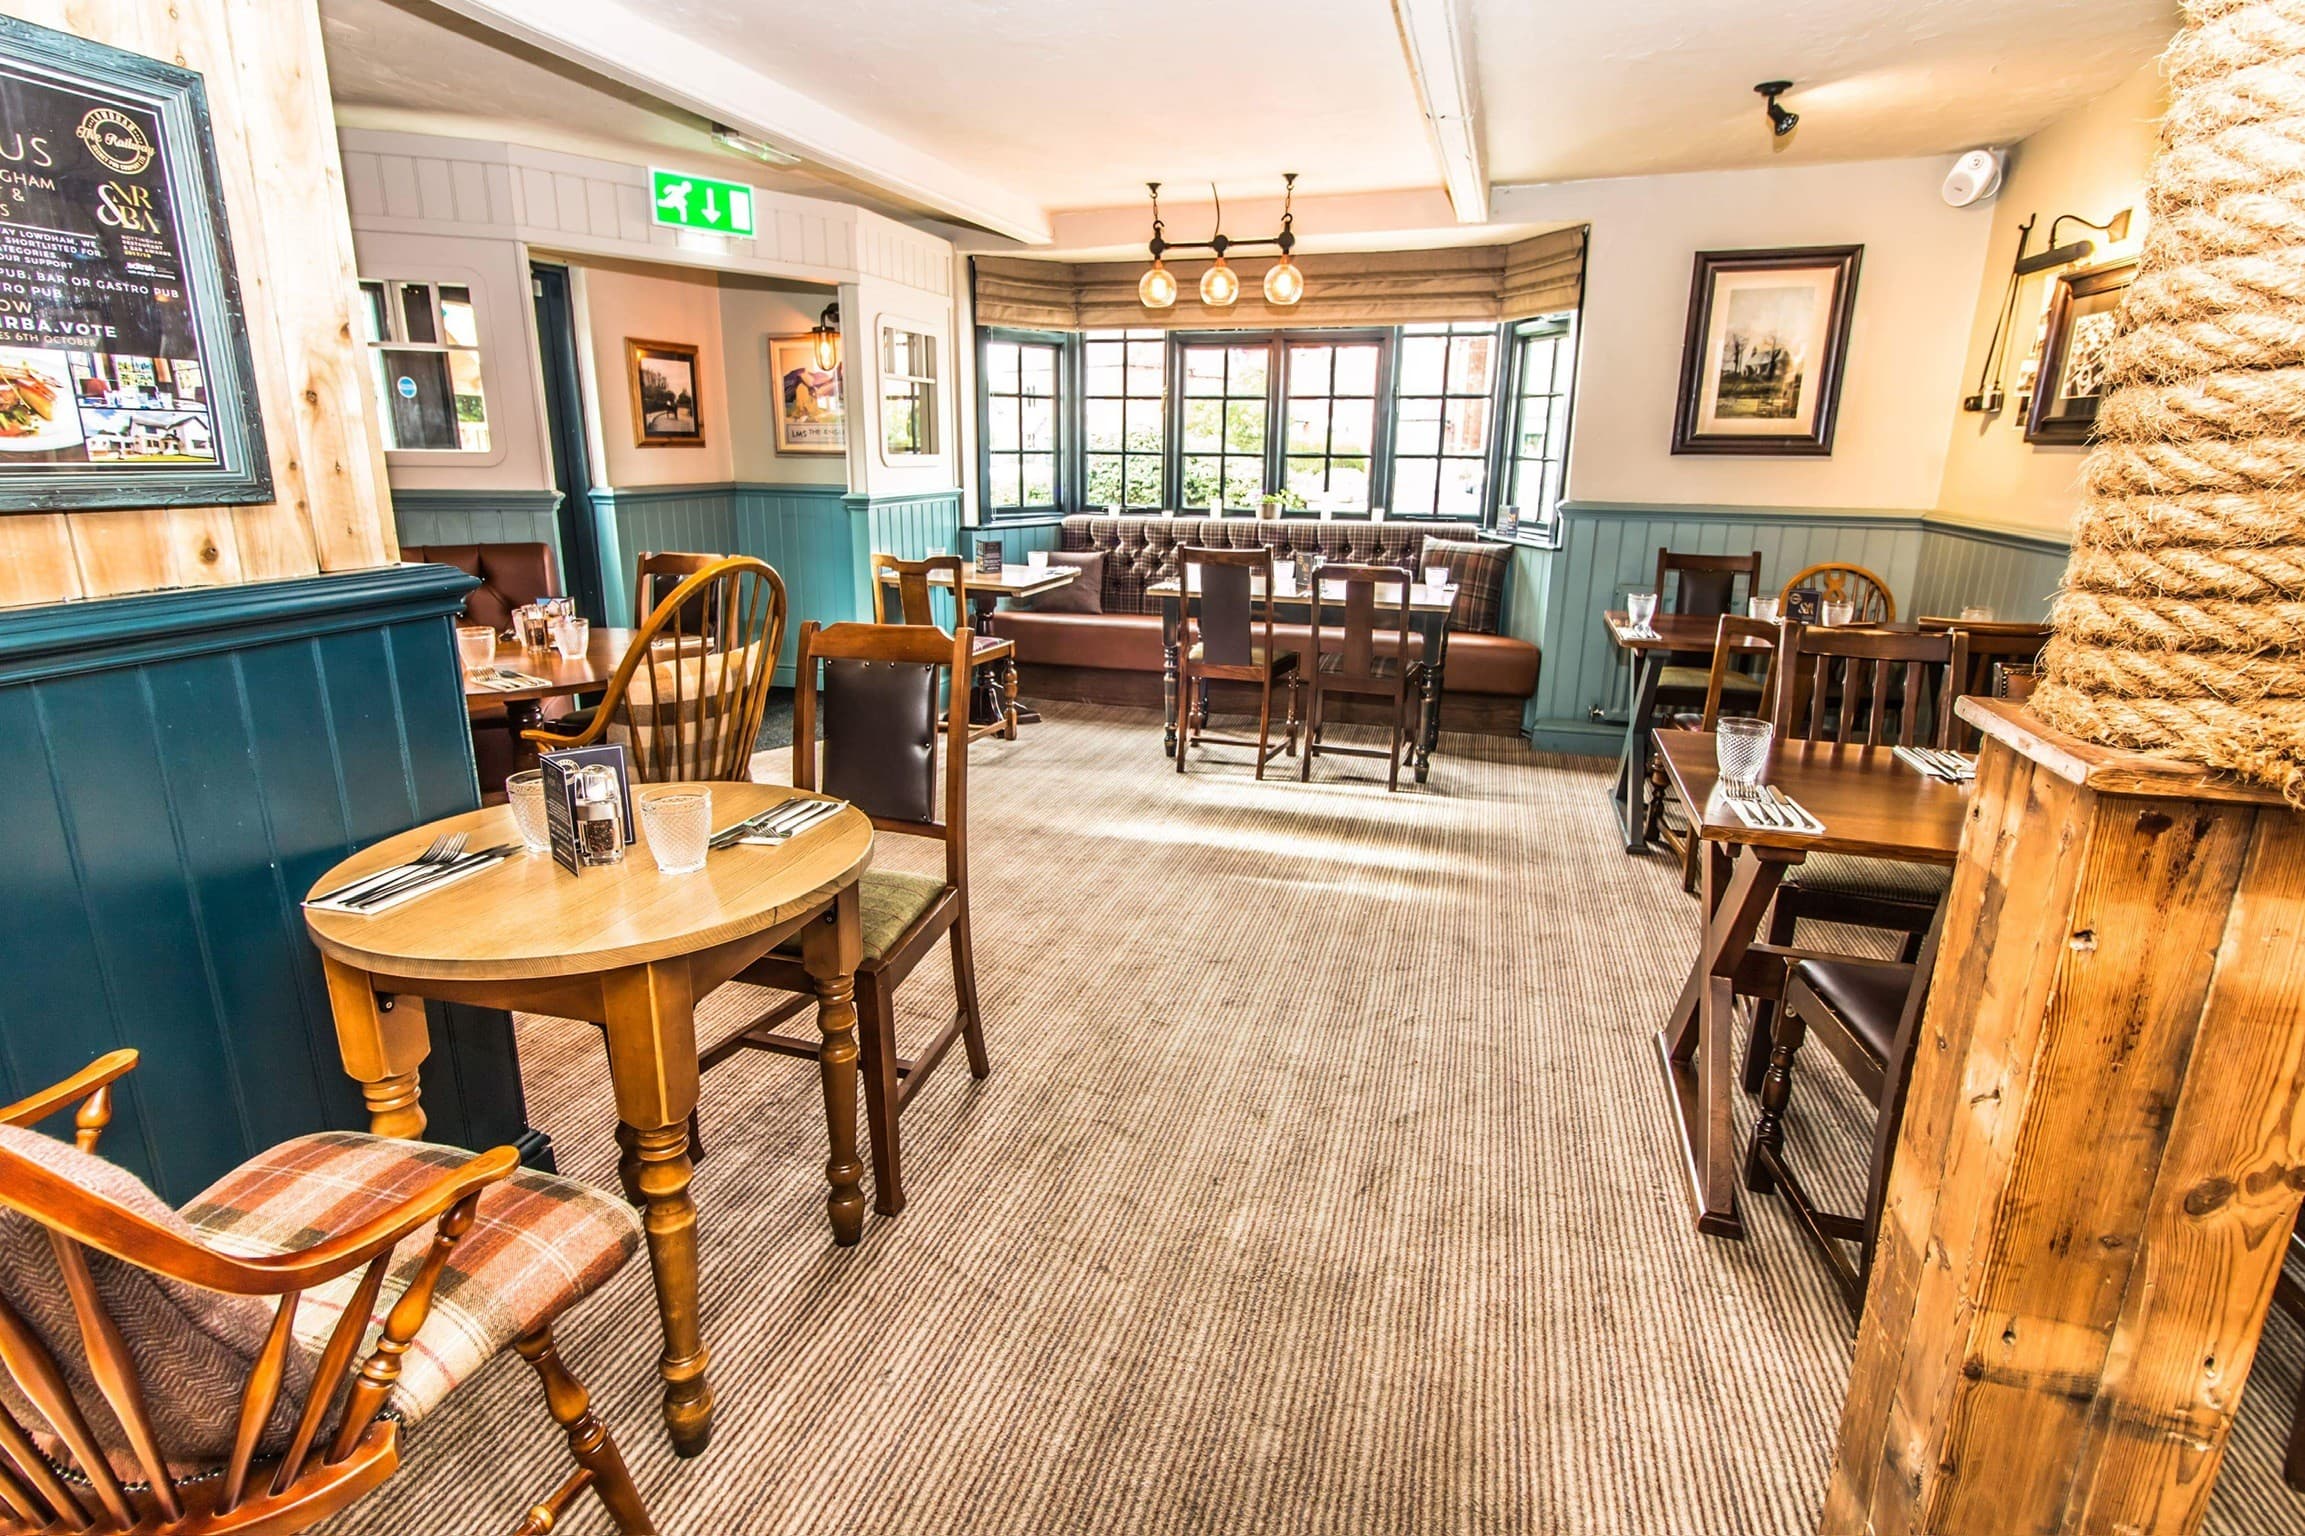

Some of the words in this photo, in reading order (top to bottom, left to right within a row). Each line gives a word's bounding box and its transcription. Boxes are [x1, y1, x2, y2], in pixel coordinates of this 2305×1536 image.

[0, 169, 55, 191] GHAM
[4, 236, 77, 254] SHORTLISTED
[81, 247, 101, 257] FOR
[80, 240, 97, 249] WE
[24, 256, 73, 269] SUPPORT
[31, 286, 63, 298] PUB
[71, 277, 91, 287] OR
[96, 280, 149, 294] GASTRO
[153, 287, 179, 298] PUB
[0, 315, 117, 338] RBA.VOTE
[15, 333, 39, 342] 6TH
[43, 335, 97, 347] OCTOBER
